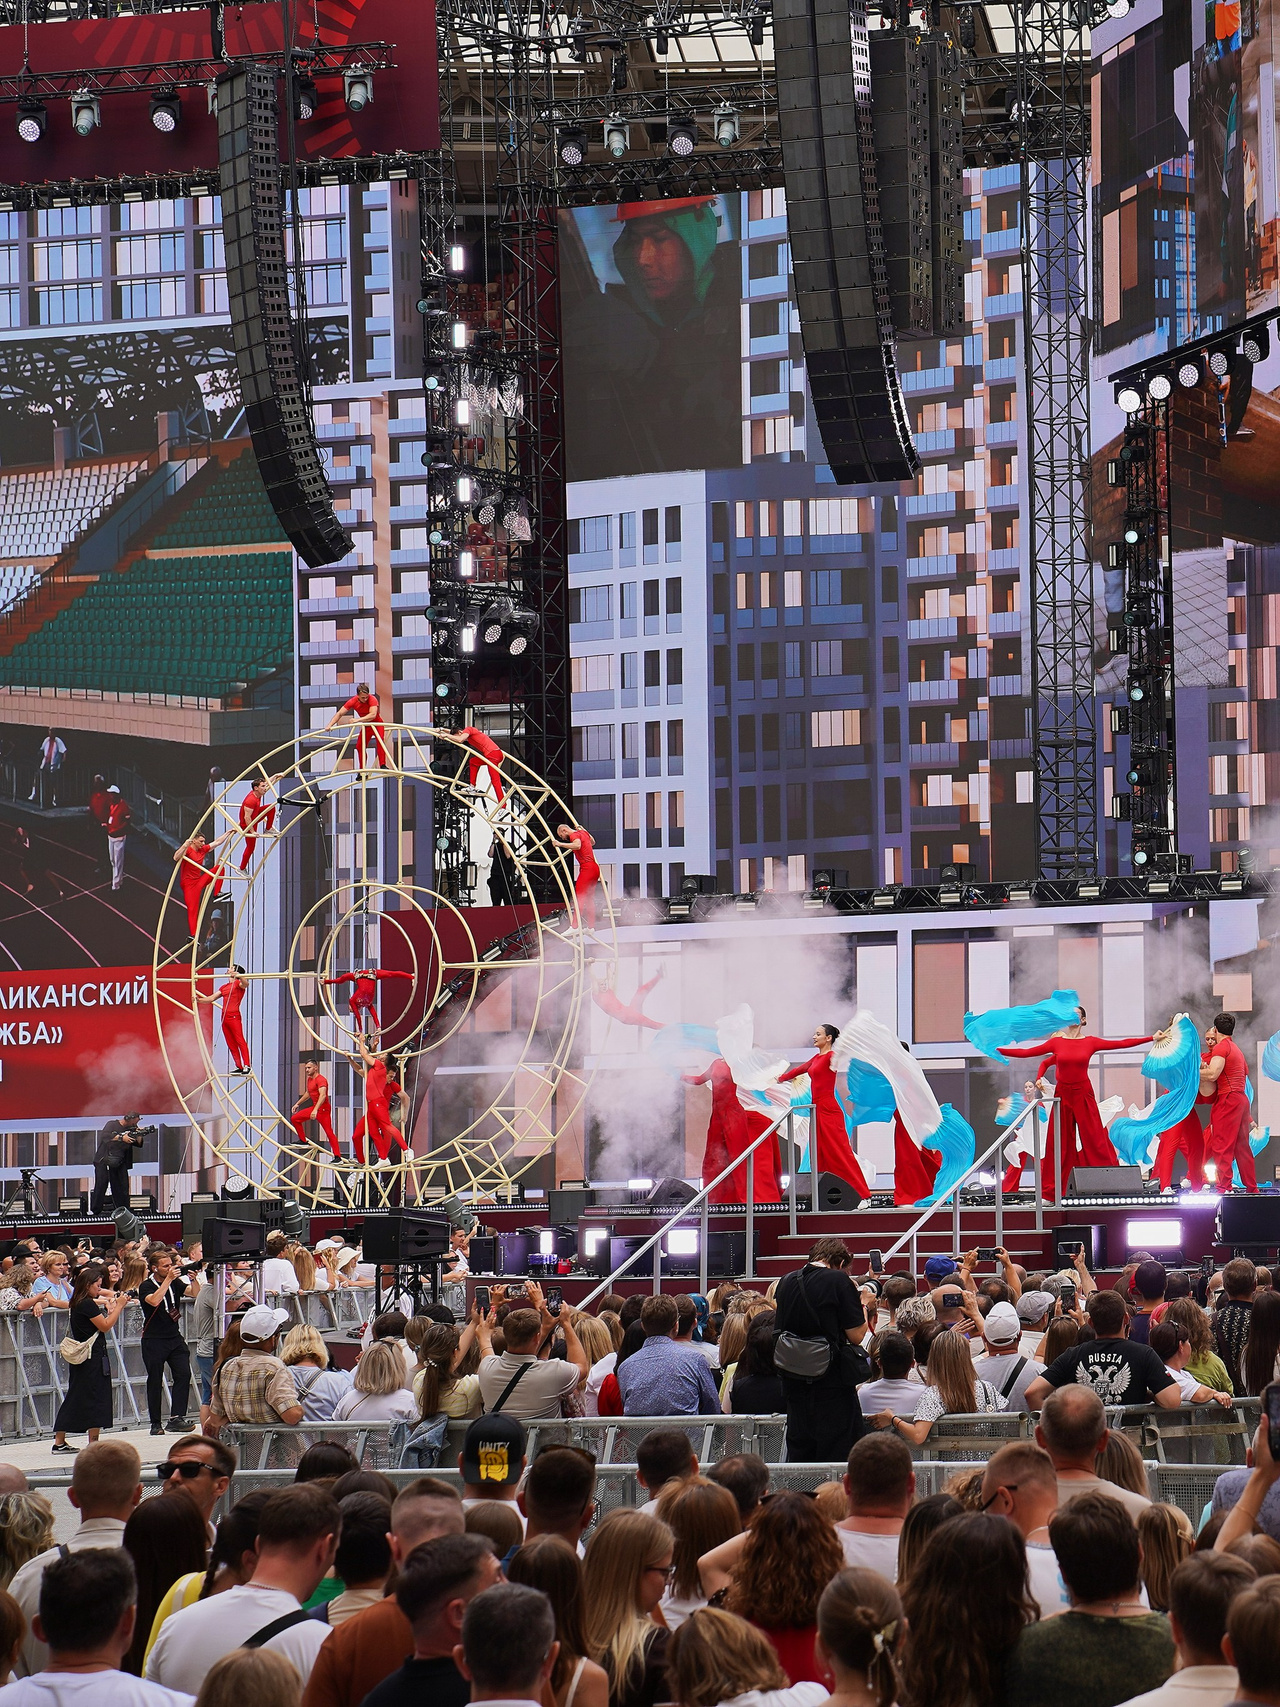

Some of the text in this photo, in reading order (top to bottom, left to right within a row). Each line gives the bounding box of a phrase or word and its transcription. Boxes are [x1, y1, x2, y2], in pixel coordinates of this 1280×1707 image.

[0, 1021, 63, 1046] ЖБА»
[1088, 1352, 1123, 1365] RUSSIA
[478, 1440, 510, 1453] UNITY
